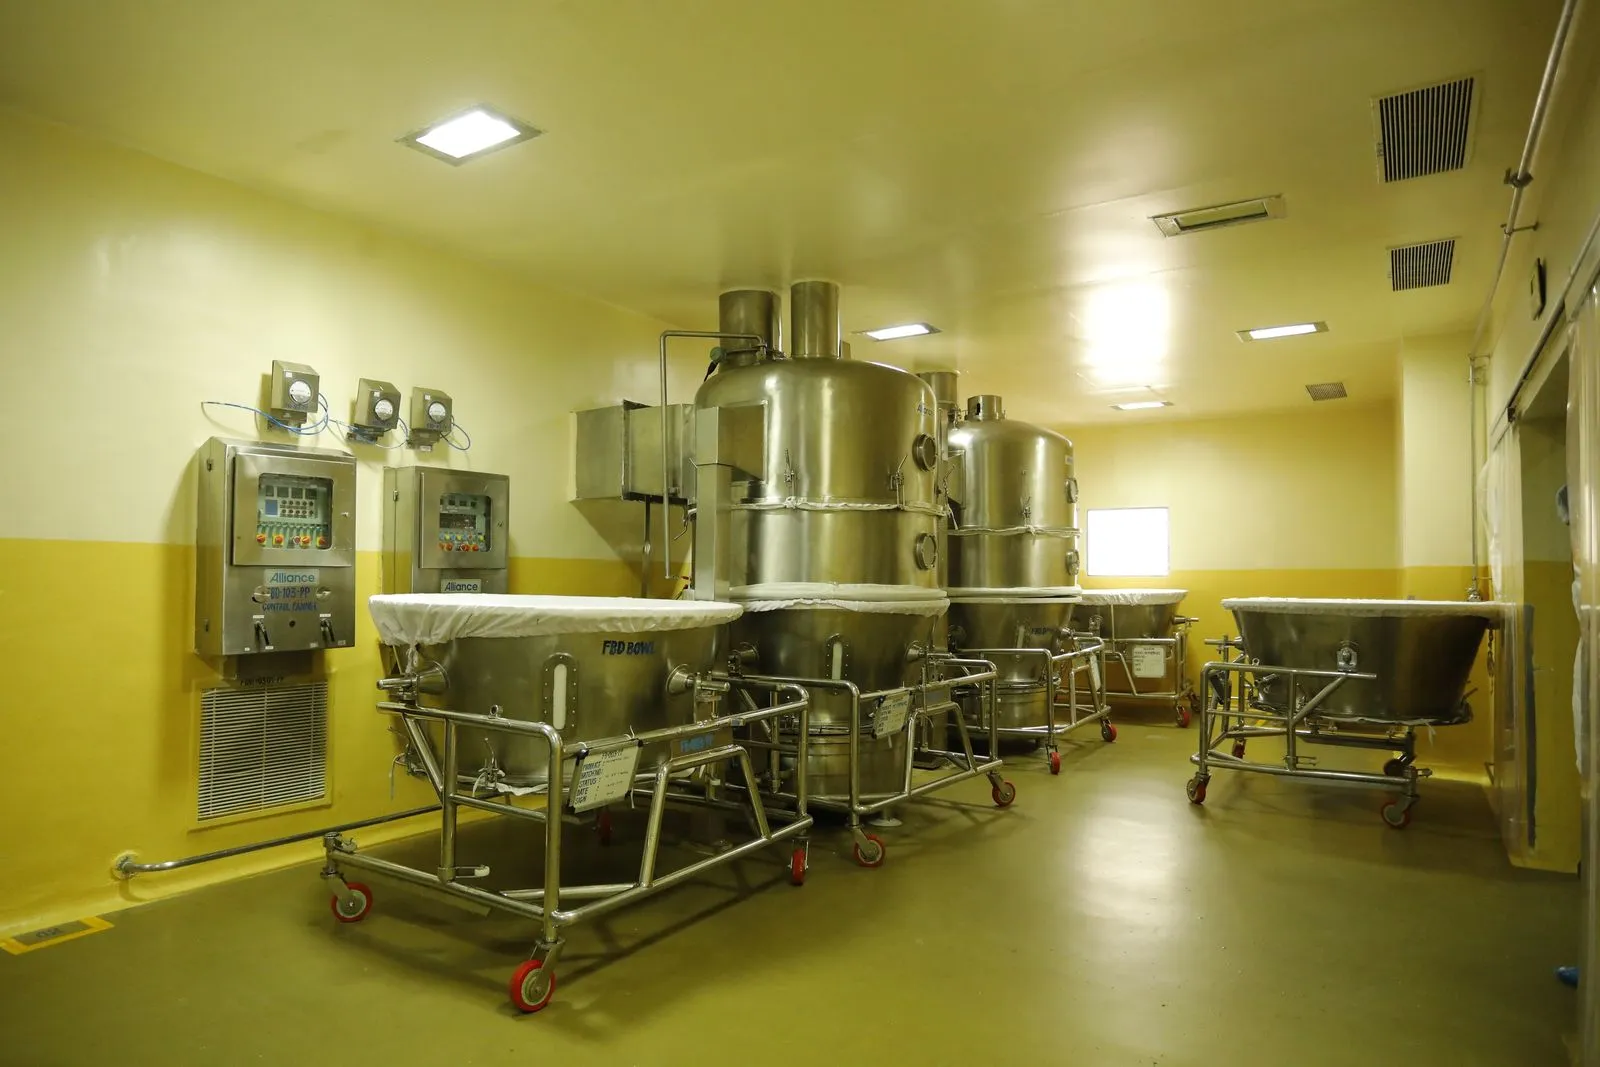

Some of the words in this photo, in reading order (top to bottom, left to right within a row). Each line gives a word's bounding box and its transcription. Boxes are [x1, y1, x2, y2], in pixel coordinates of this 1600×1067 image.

[269, 572, 315, 584] Alliance
[444, 581, 478, 591] Alliance
[602, 640, 626, 656] FBD
[626, 641, 655, 656] BOWL
